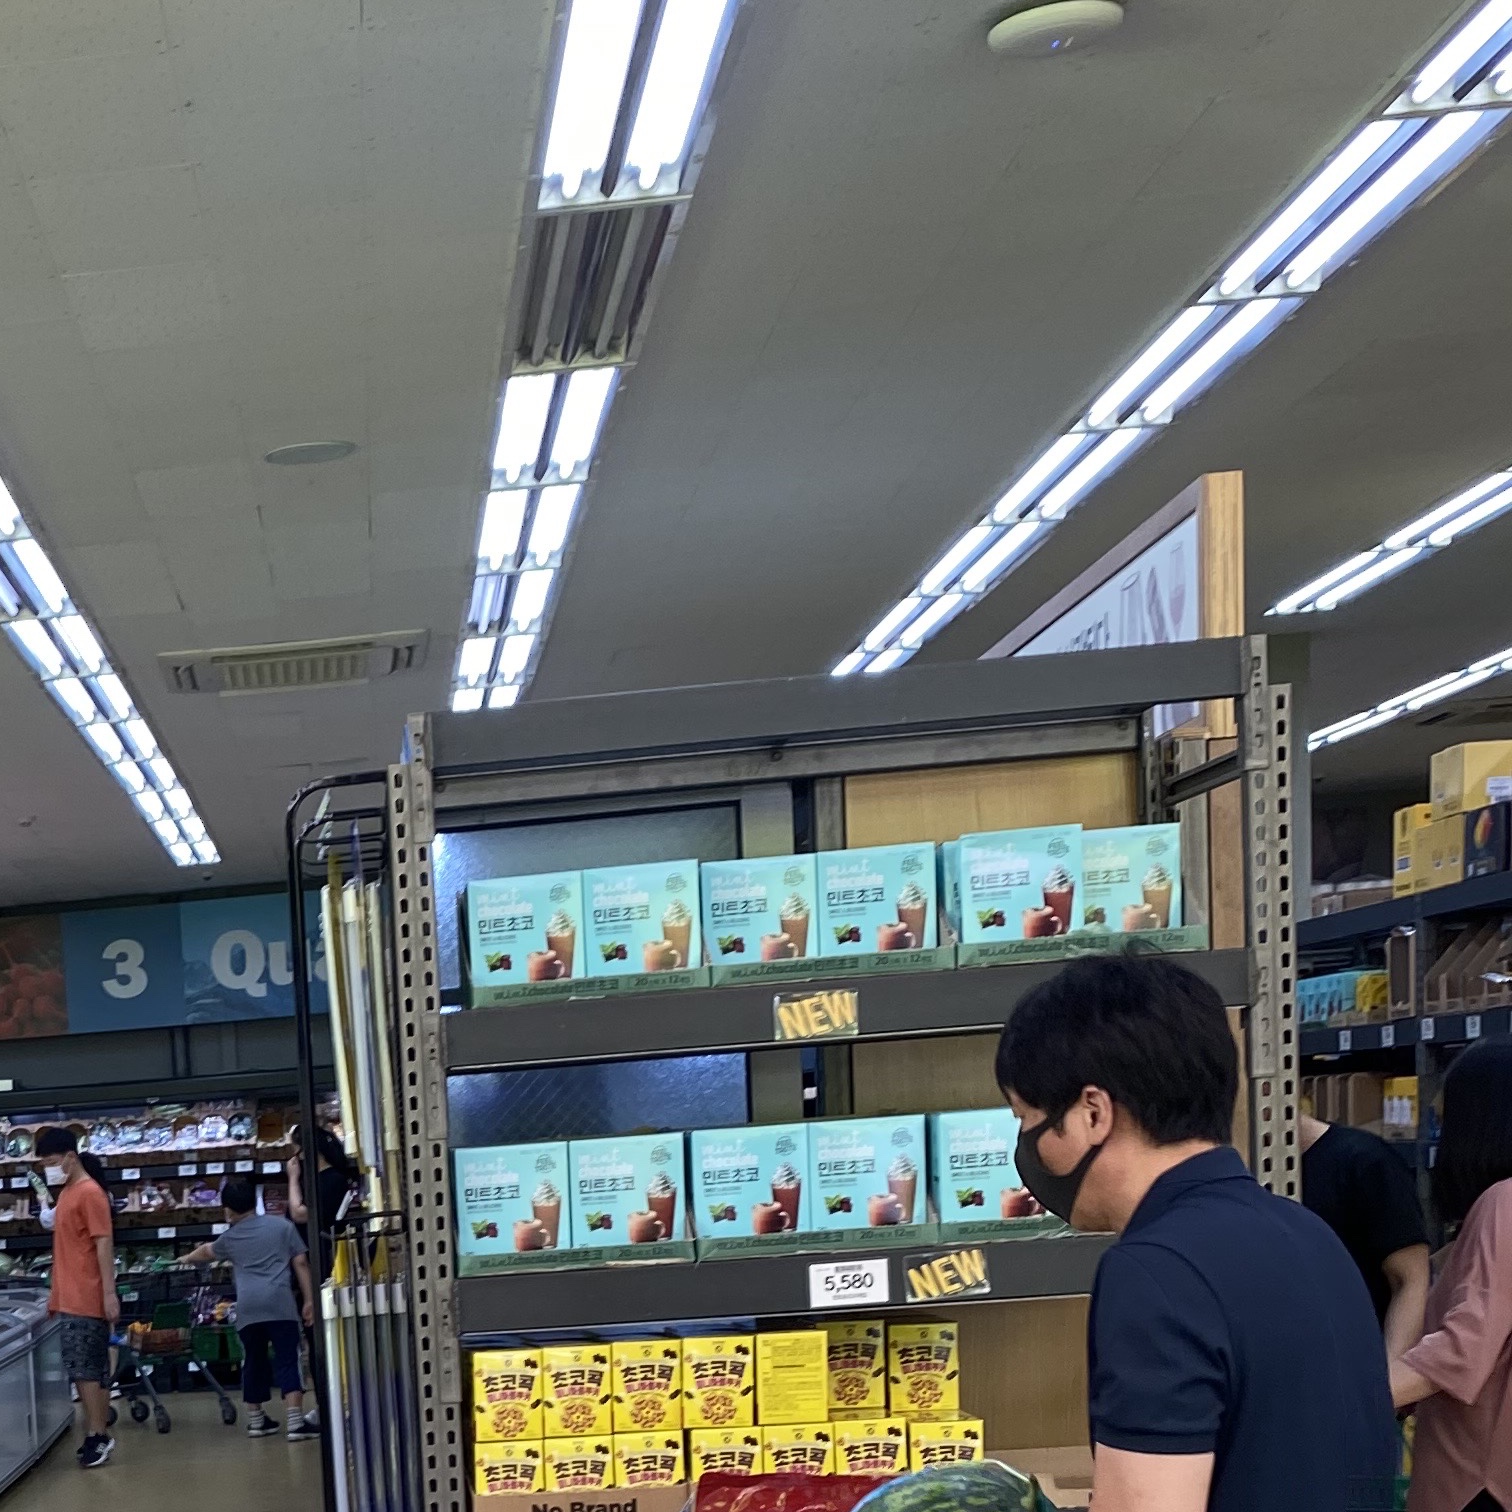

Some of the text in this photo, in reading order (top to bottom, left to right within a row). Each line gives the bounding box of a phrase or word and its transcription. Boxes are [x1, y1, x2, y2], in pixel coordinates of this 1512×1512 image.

[970, 870, 1031, 890] 민트초코
[826, 887, 885, 906] 민트초코
[593, 904, 650, 924] 민트초코
[711, 898, 768, 917] 민트초코
[478, 915, 534, 934] 민트초코
[101, 939, 148, 999] 3
[777, 989, 858, 1040] NEW
[818, 1158, 876, 1177] 민트초코
[950, 1151, 1009, 1170] 민트초코
[579, 1176, 635, 1195] 민트초코
[703, 1167, 760, 1185] 민트초코
[464, 1184, 521, 1203] 민트초코
[823, 1271, 874, 1293] 5,580
[907, 1249, 986, 1298] NEW
